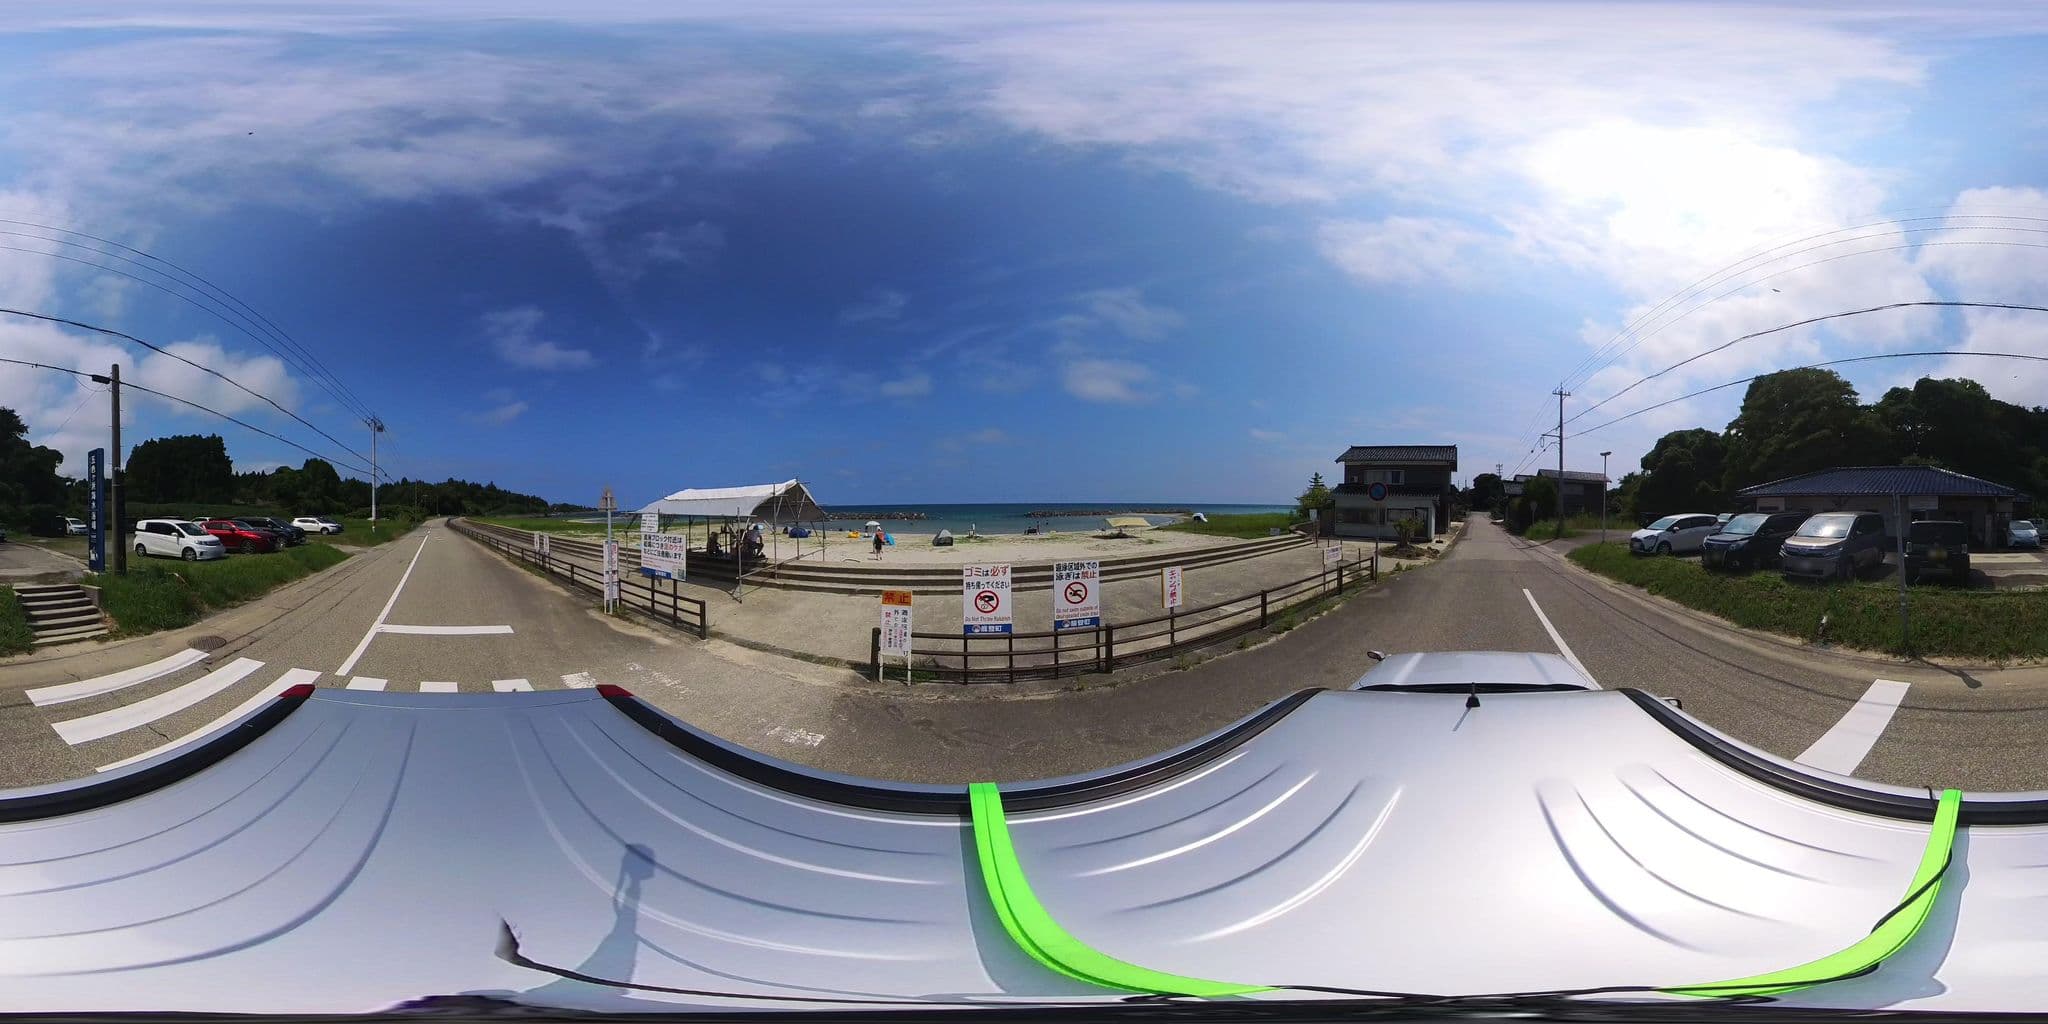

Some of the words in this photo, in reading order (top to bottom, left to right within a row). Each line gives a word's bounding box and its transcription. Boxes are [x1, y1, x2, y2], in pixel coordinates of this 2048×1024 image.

[964, 565, 1010, 577] ゴミは必ず
[965, 581, 1010, 590] 持ち帰ってください
[884, 592, 910, 605] 禁止
